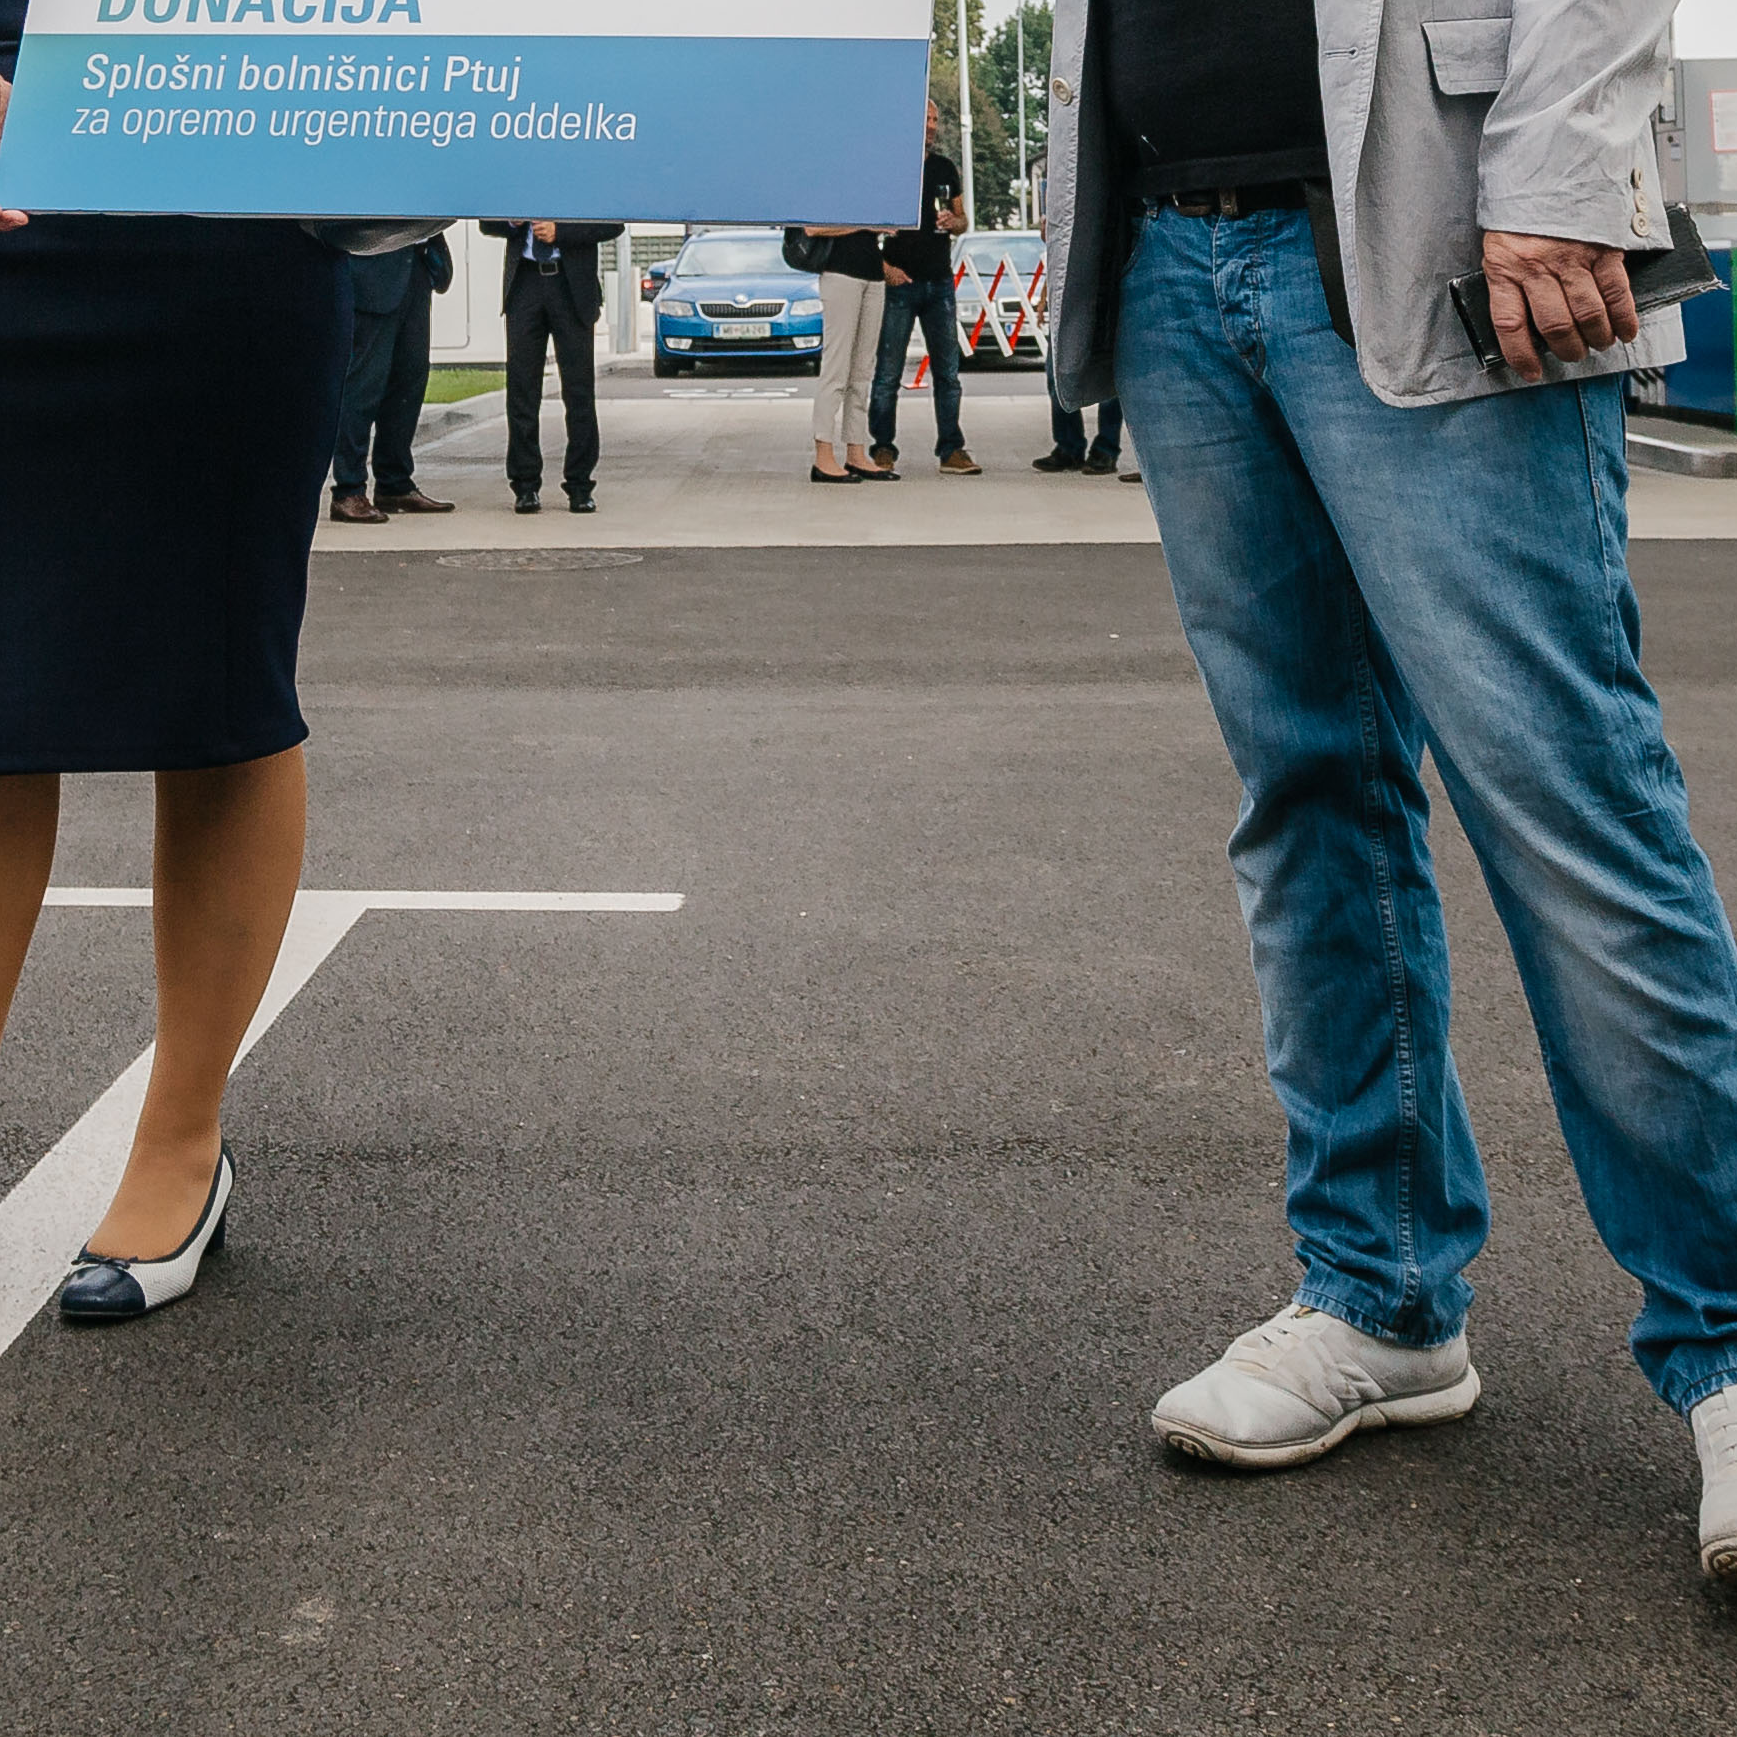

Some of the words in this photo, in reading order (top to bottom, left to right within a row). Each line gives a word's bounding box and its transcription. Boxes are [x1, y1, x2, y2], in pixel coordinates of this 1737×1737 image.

[82, 53, 227, 98] Splošni
[238, 54, 430, 93] bolnišnici
[443, 55, 522, 102] Ptuj
[71, 108, 110, 135] za
[122, 107, 256, 144] opremo
[269, 104, 476, 147] urgentnega
[490, 103, 637, 141] oddelka
